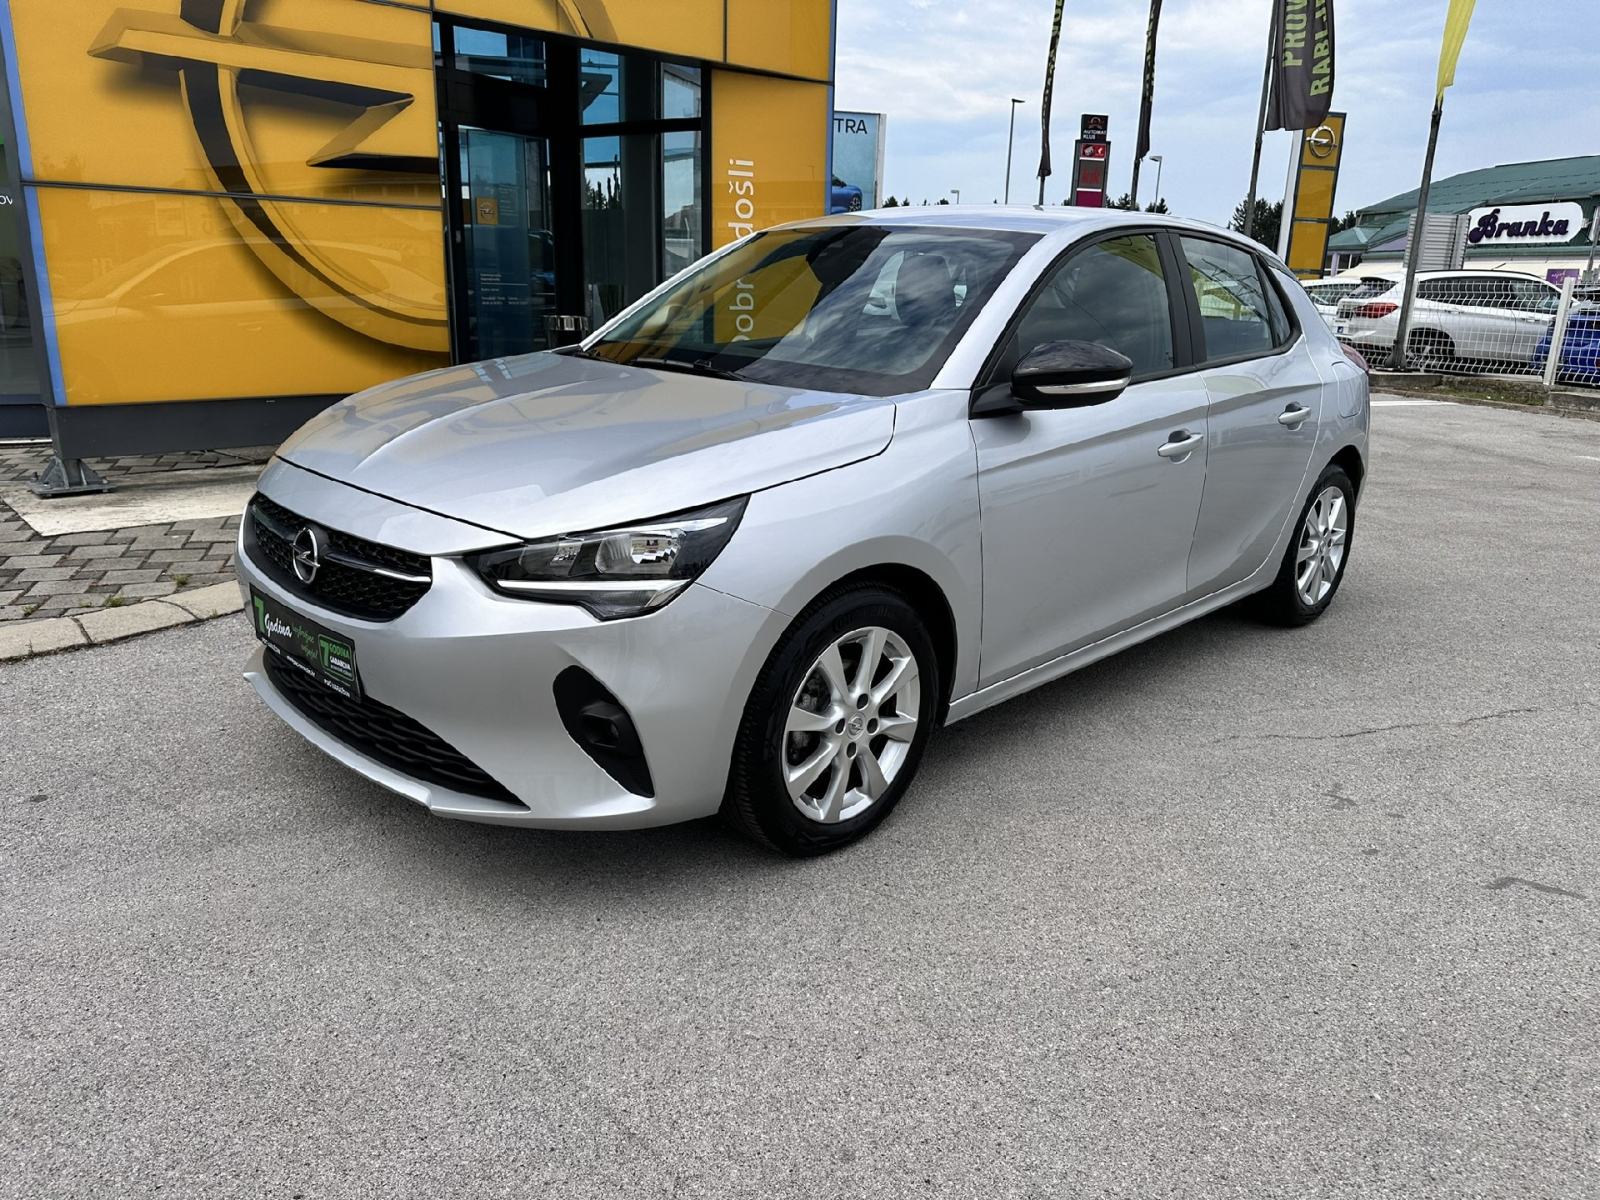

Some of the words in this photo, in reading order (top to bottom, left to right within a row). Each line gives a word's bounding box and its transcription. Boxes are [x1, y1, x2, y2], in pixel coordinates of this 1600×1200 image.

[728, 159, 754, 240] došli
[1469, 208, 1569, 243] Branka
[729, 277, 754, 343] obr
